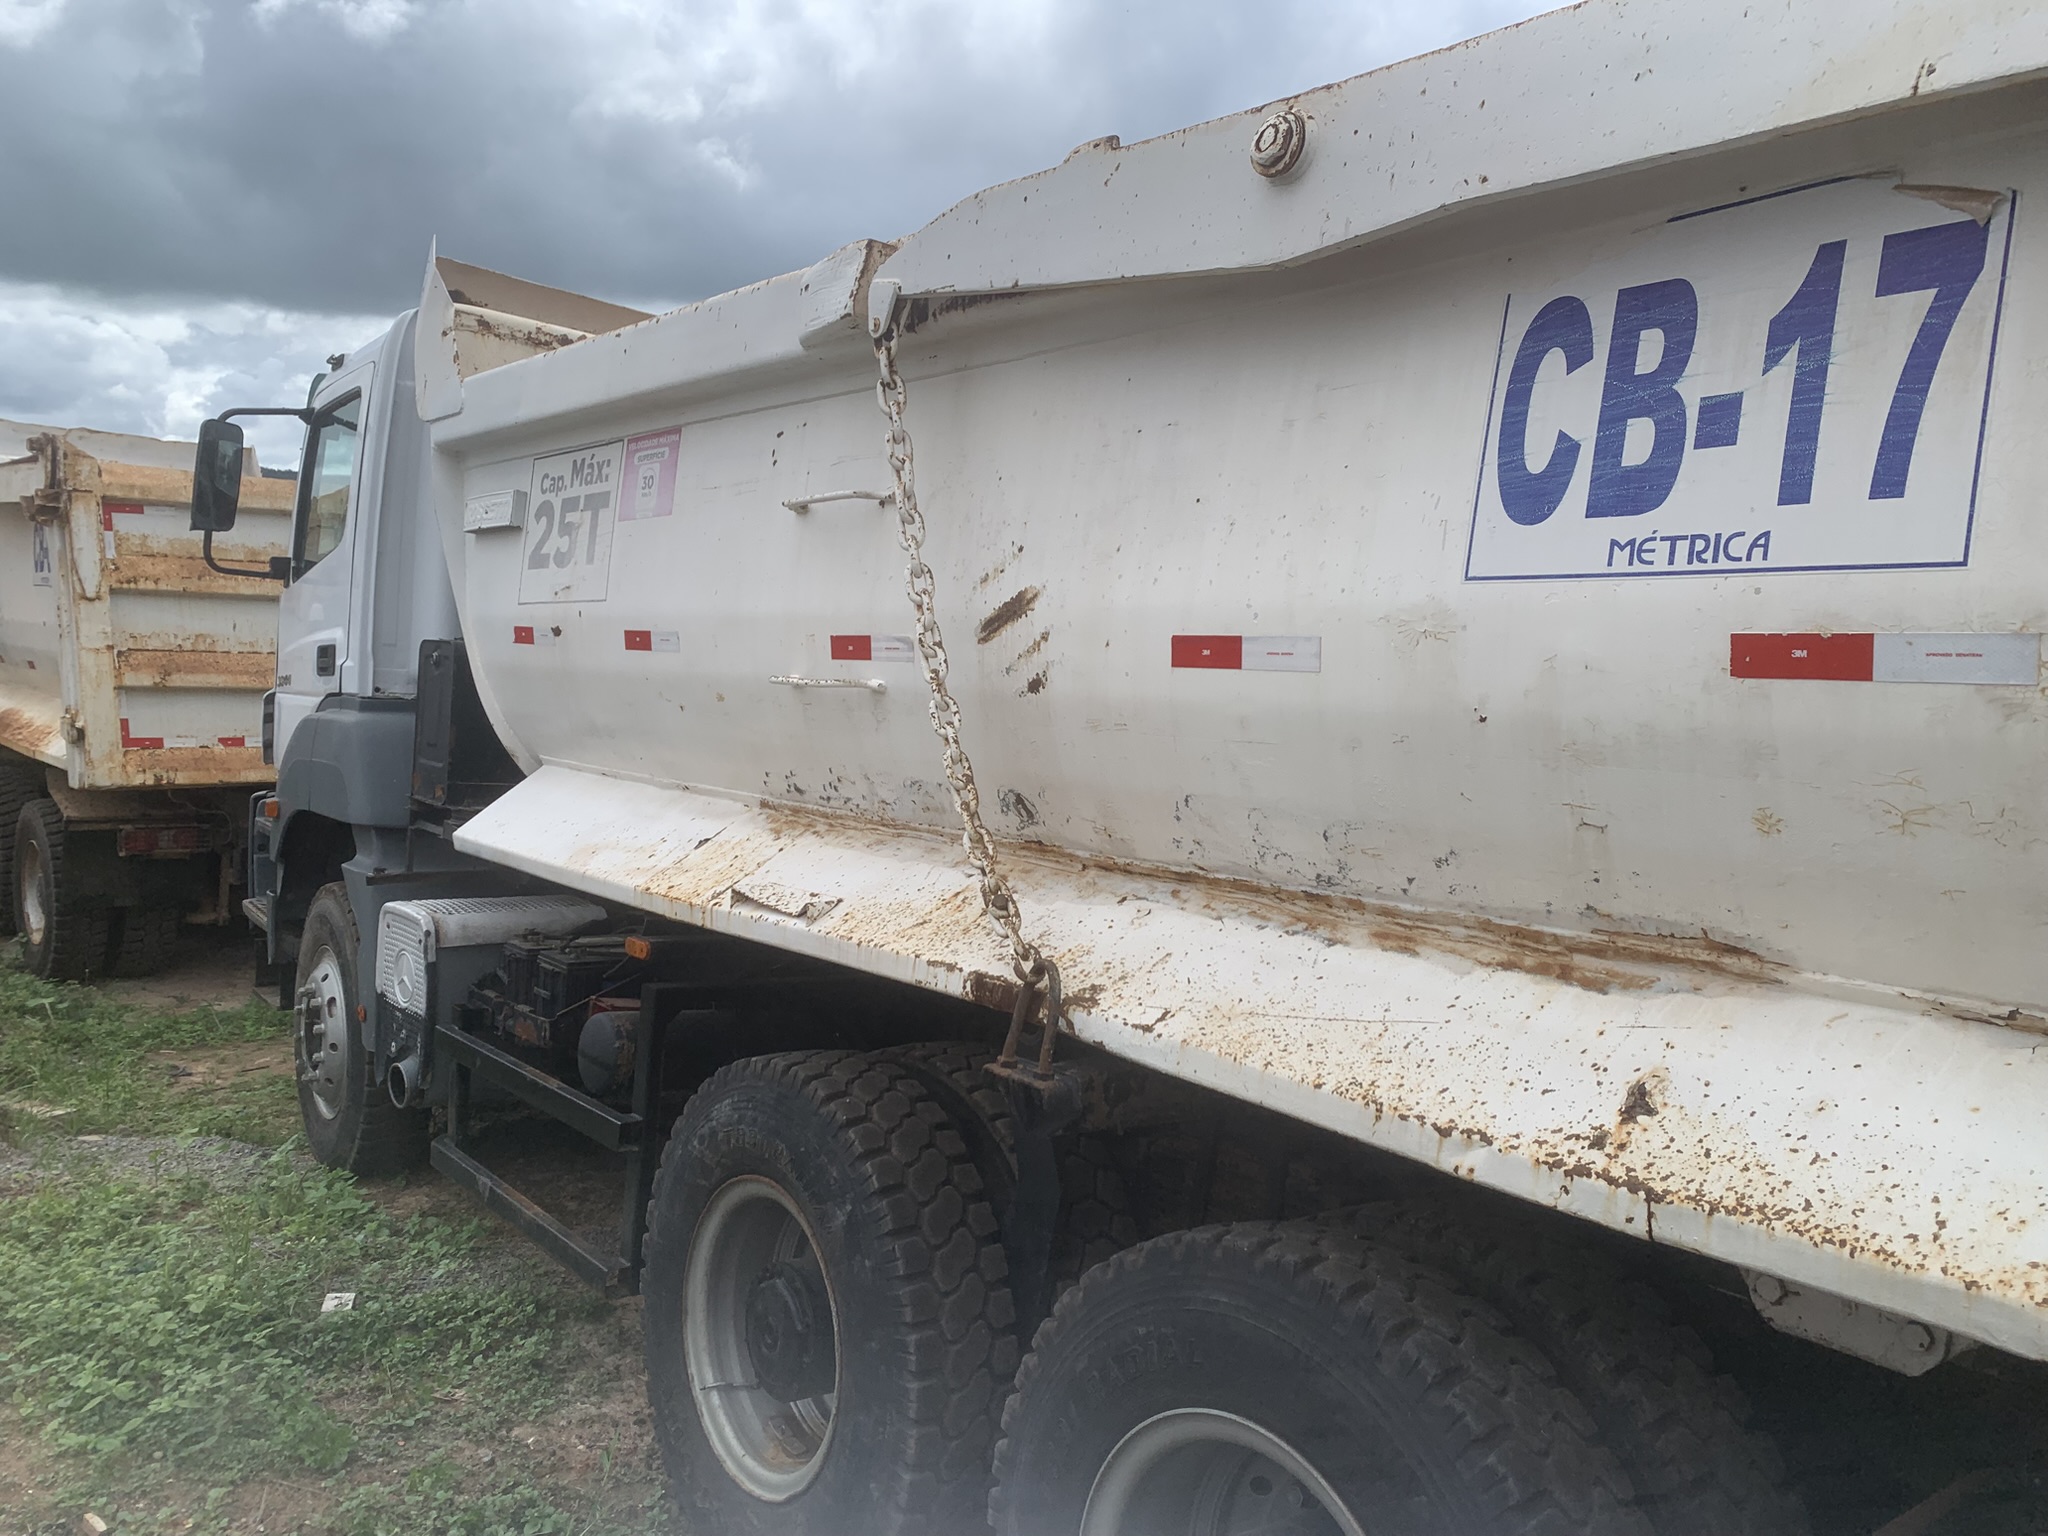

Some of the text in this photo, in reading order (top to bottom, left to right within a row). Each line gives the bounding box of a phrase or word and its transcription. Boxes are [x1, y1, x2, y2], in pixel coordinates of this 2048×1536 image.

[1497, 216, 1991, 526] CB-17
[540, 453, 611, 498] Cap. Máx:
[641, 475, 654, 490] 30
[527, 491, 611, 570] 25T
[1606, 530, 1771, 568] MÉTRICA
[1791, 649, 1807, 658] 3M
